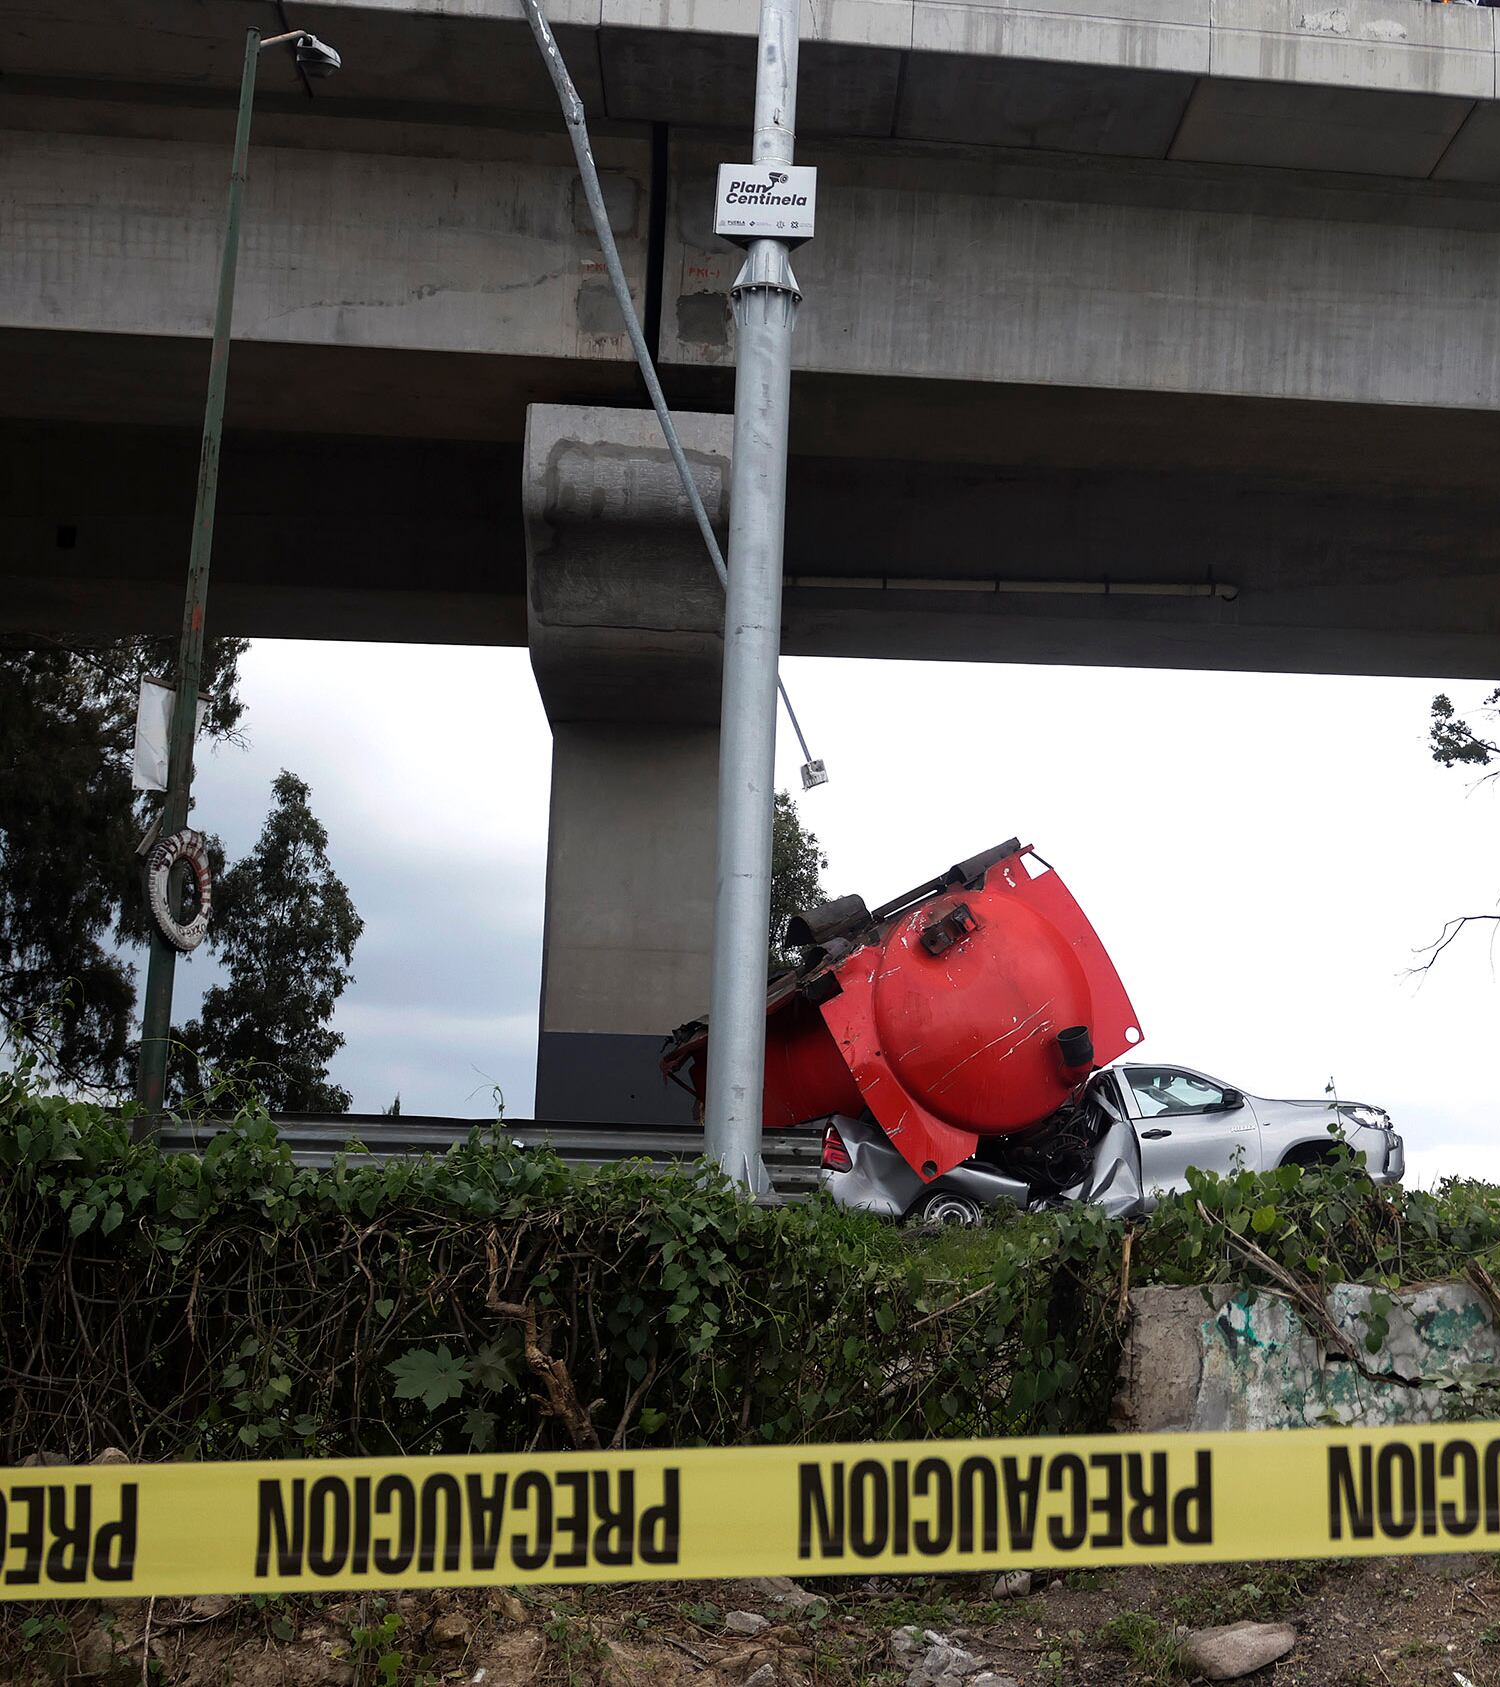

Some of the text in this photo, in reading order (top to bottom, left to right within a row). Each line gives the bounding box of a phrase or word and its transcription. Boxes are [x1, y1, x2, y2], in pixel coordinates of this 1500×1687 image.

[725, 192, 808, 206] Centinela
[729, 181, 766, 193] Plan
[0, 1482, 139, 1586] PRE
[254, 1467, 681, 1578] PRECAUCION
[798, 1449, 1213, 1560] PRECAUCION
